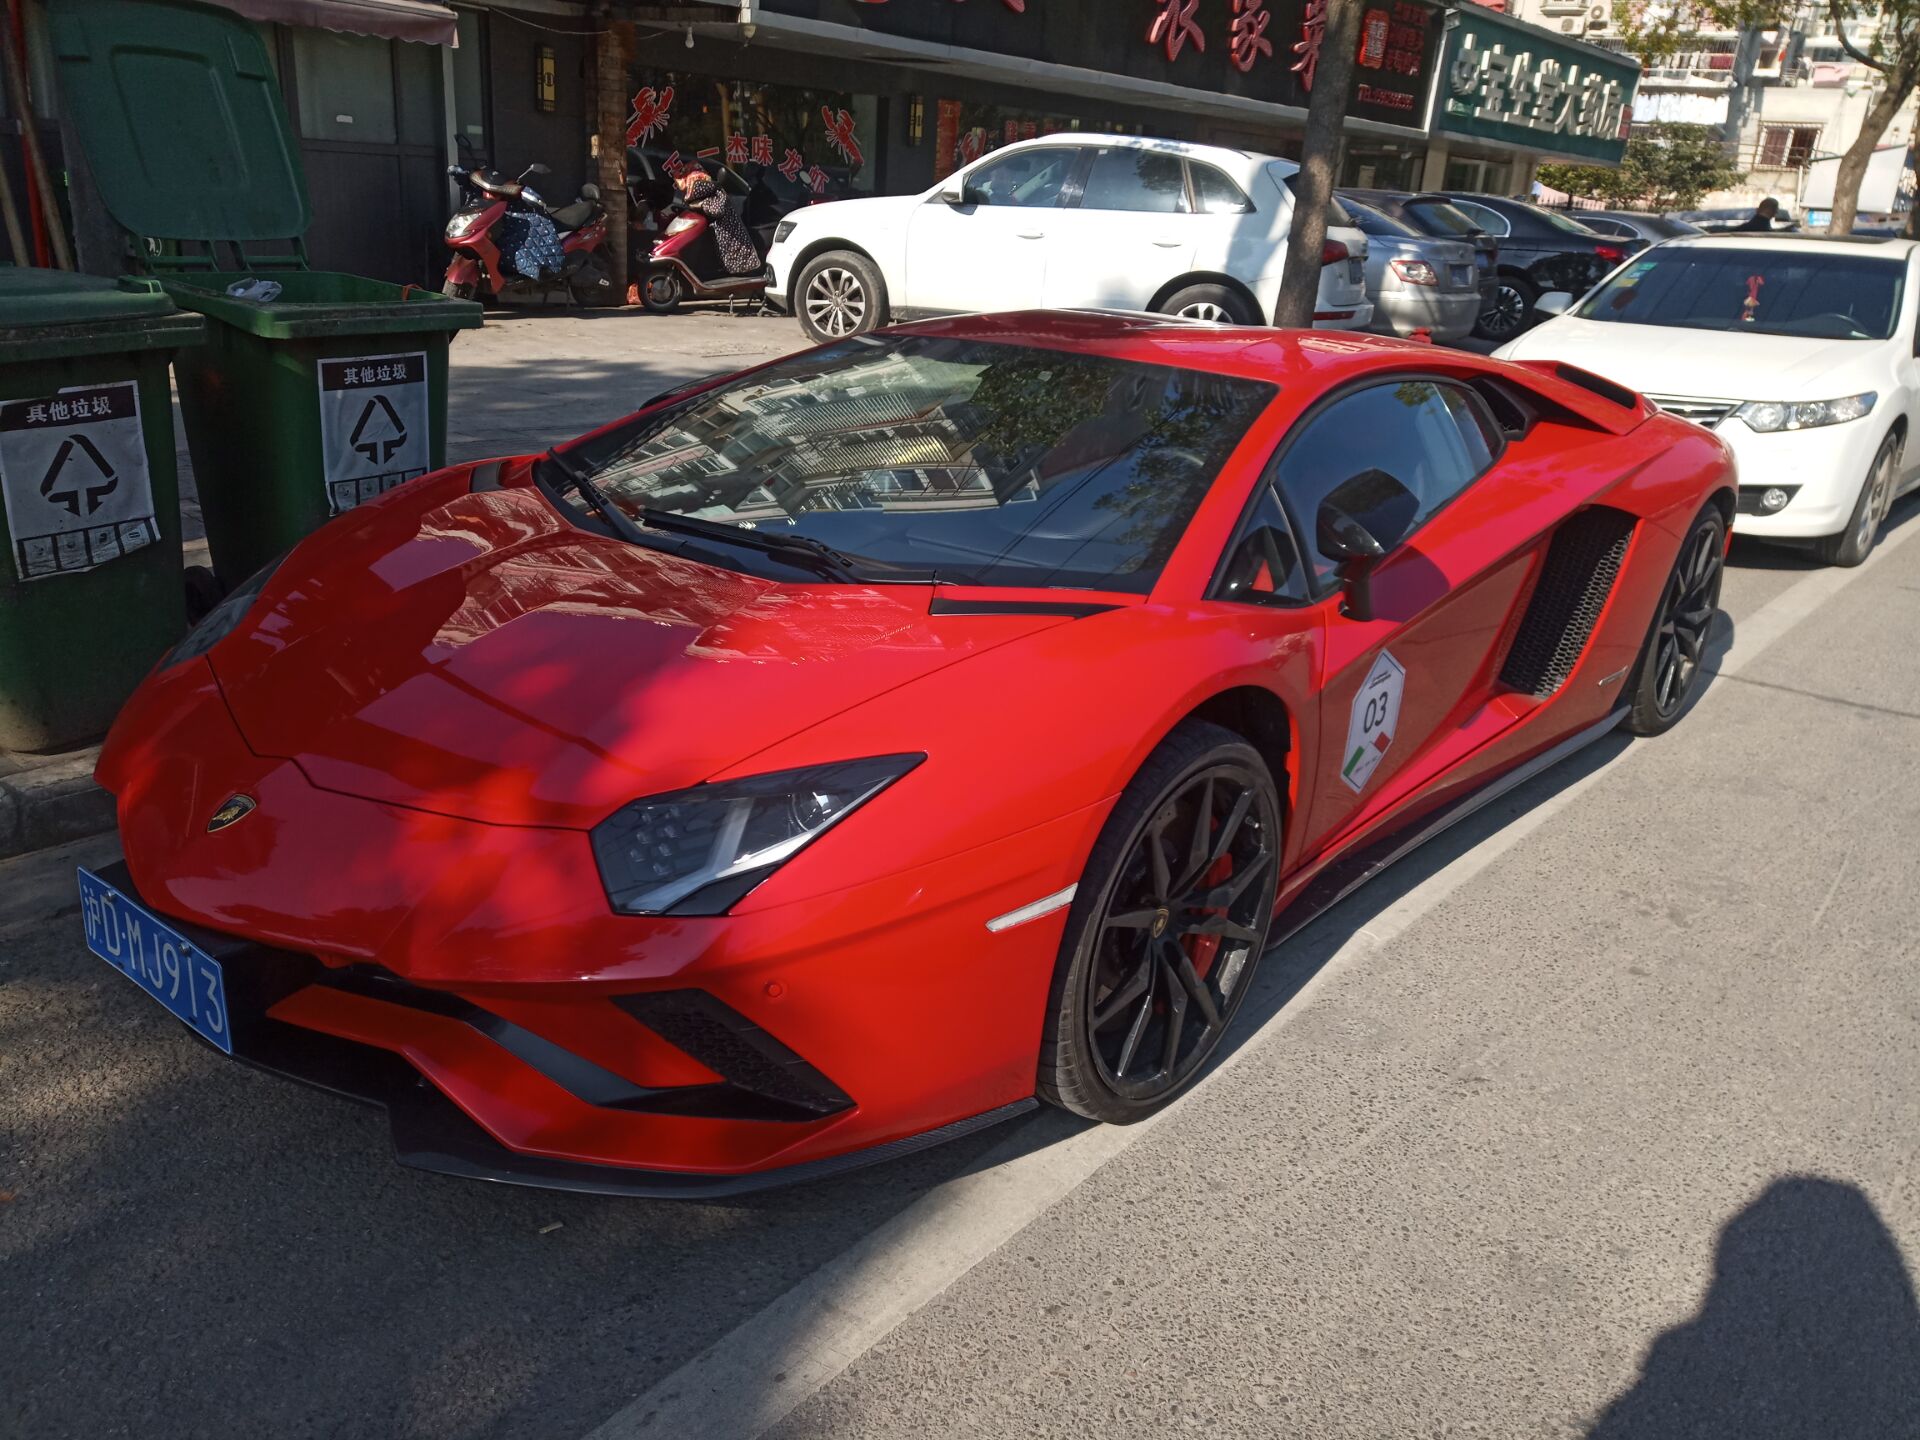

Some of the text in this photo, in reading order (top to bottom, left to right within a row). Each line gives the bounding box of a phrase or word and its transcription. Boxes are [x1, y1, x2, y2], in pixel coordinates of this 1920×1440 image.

[343, 363, 408, 386] 其他垃圾
[25, 396, 113, 424] 其他垃圾
[1363, 690, 1389, 735] 03
